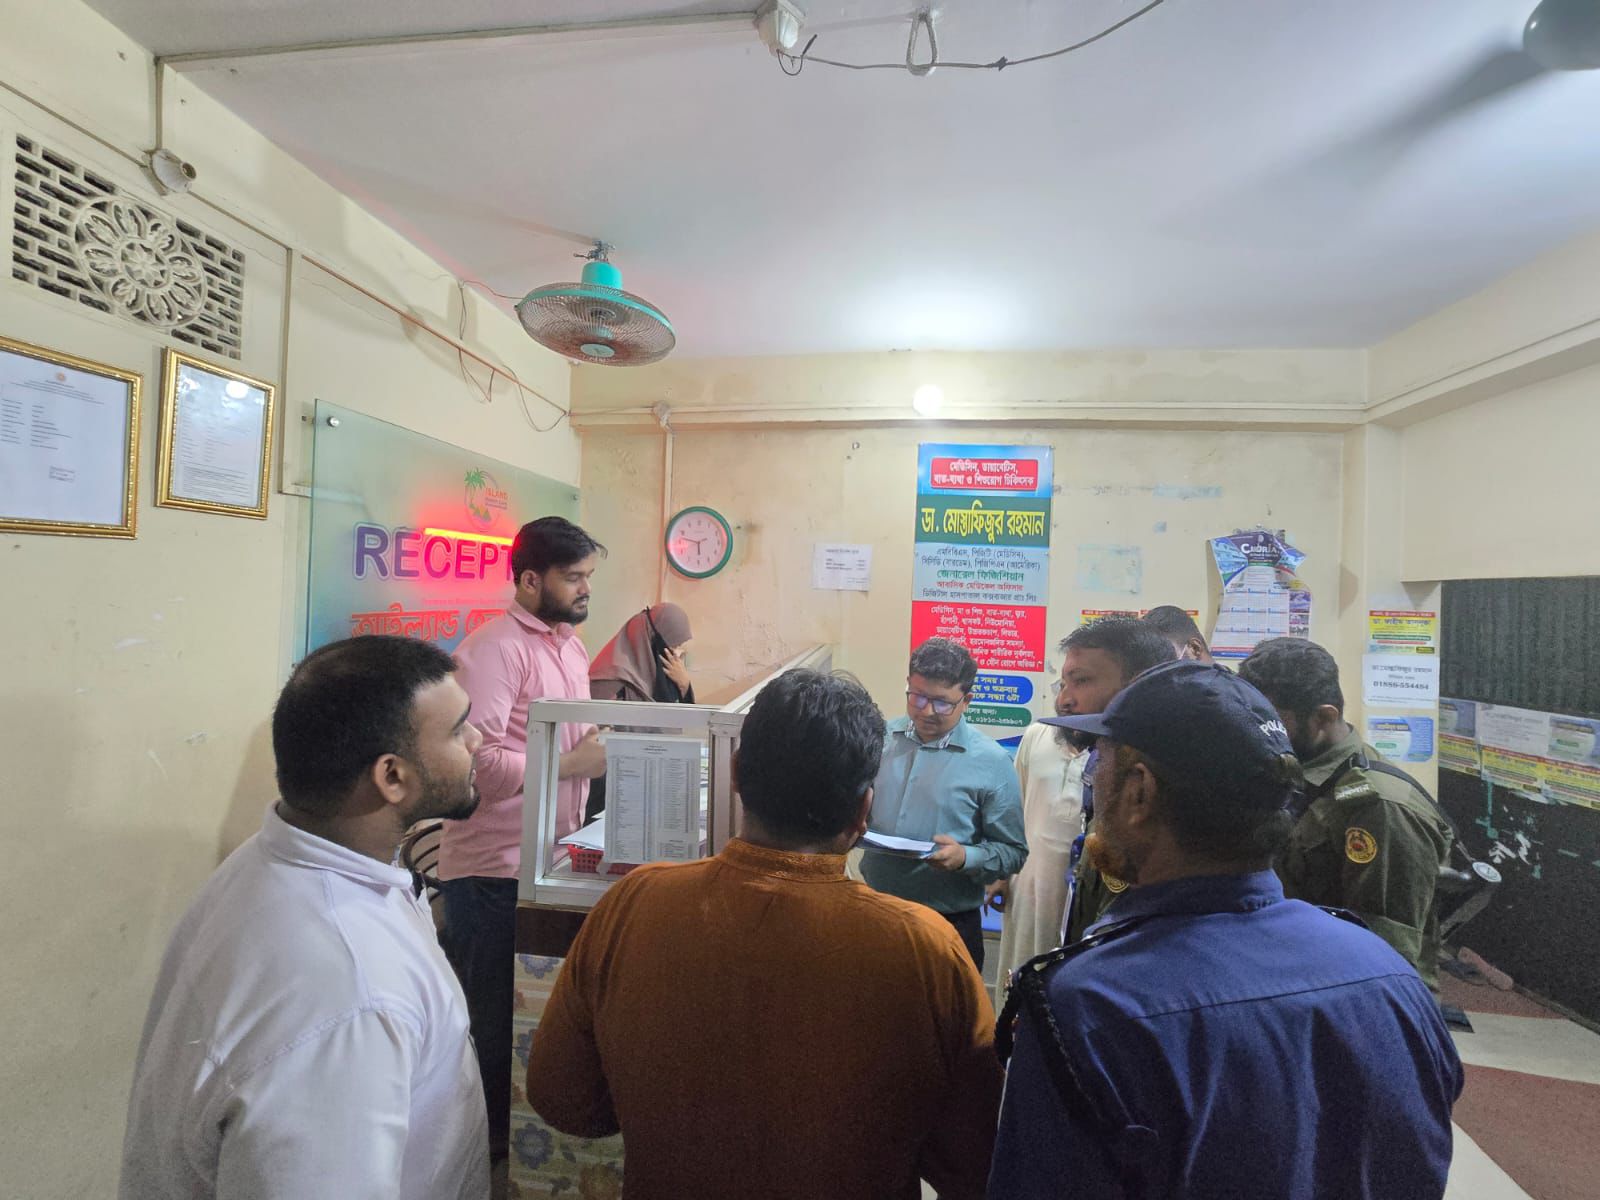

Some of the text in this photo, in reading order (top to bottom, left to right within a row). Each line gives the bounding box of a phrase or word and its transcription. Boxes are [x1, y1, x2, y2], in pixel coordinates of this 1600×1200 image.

[921, 499, 1045, 544] ডা. মোস্তাফিজুর রহমান
